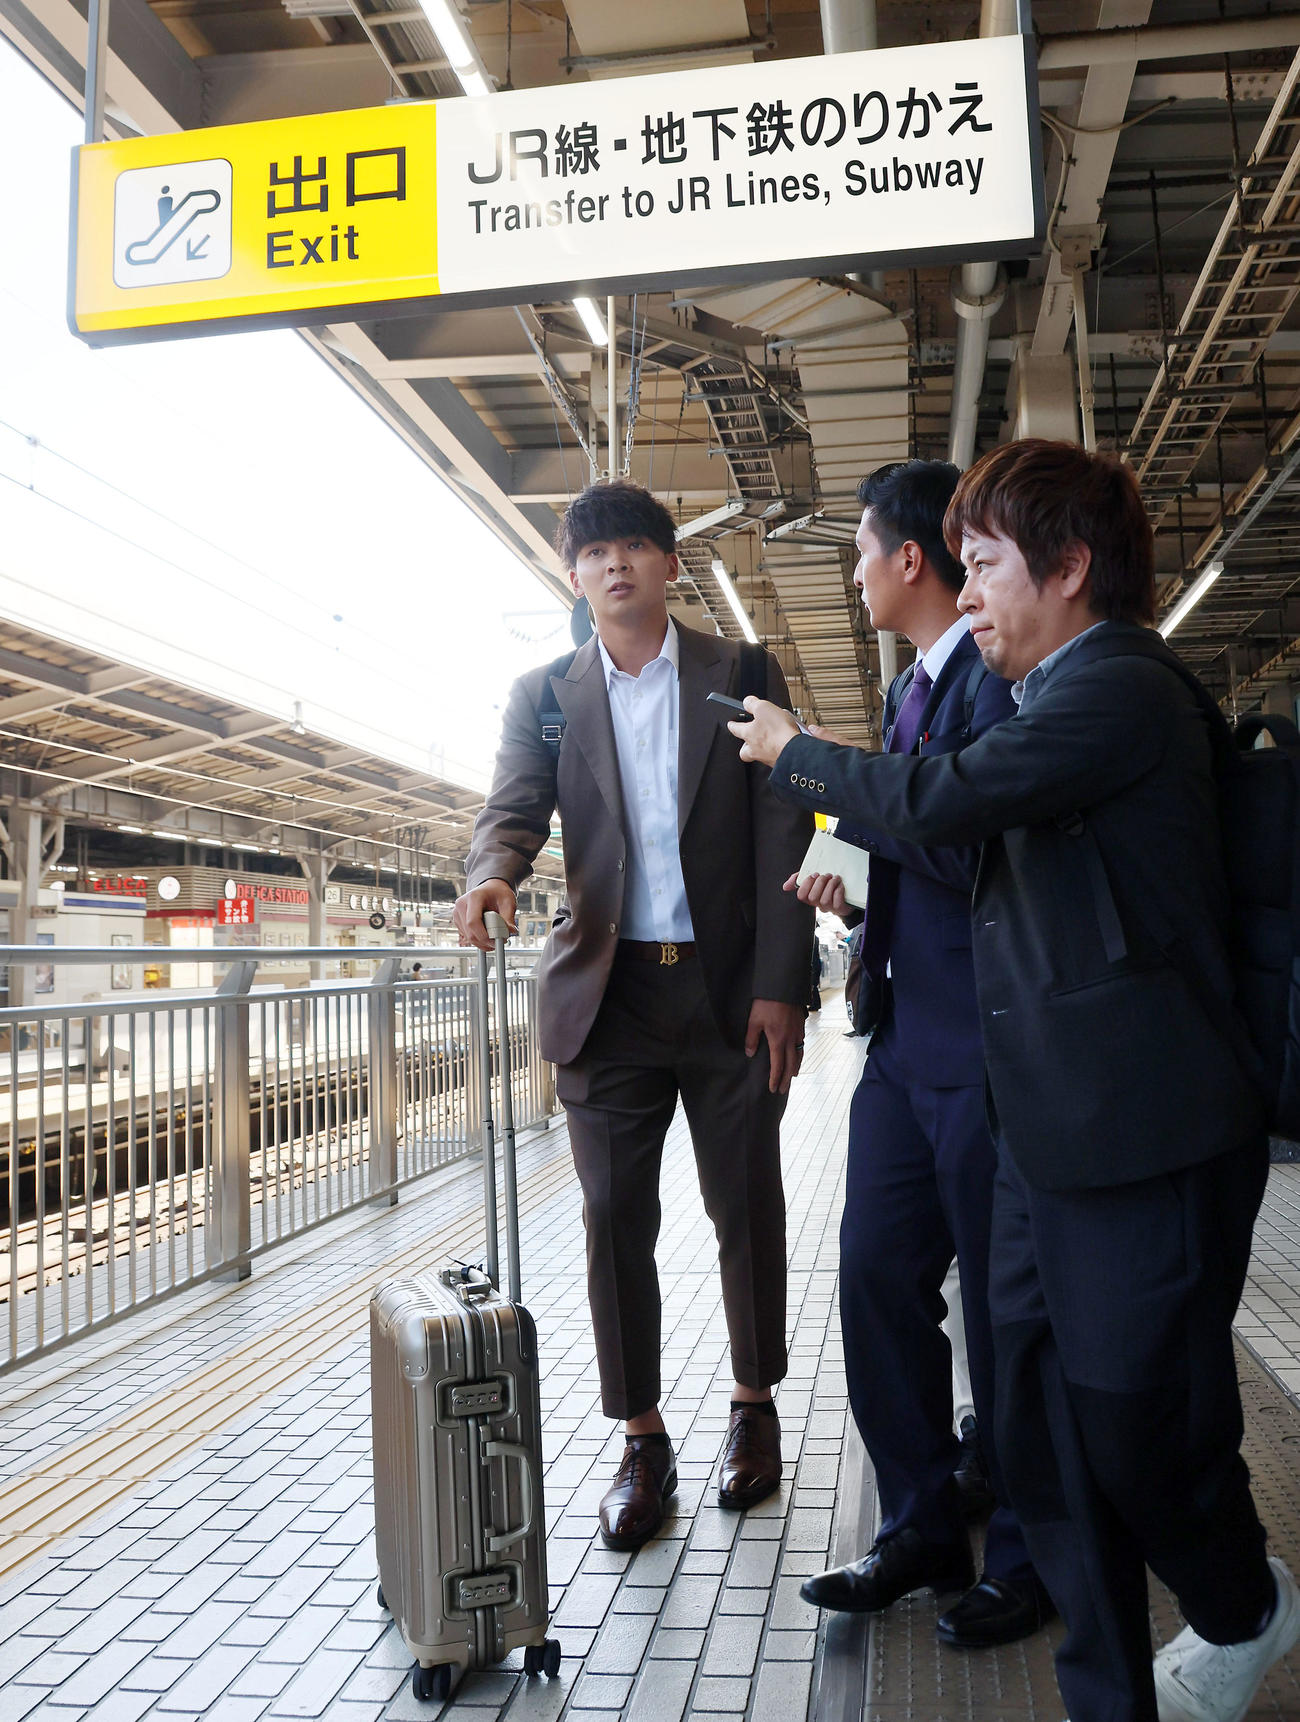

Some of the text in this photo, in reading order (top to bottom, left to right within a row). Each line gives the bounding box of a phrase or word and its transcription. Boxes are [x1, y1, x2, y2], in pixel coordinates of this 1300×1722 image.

[268, 147, 407, 219] 出口
[468, 157, 985, 234] Transfer to JR Lines, Subway
[268, 226, 360, 269] Exit
[327, 889, 337, 900] 26
